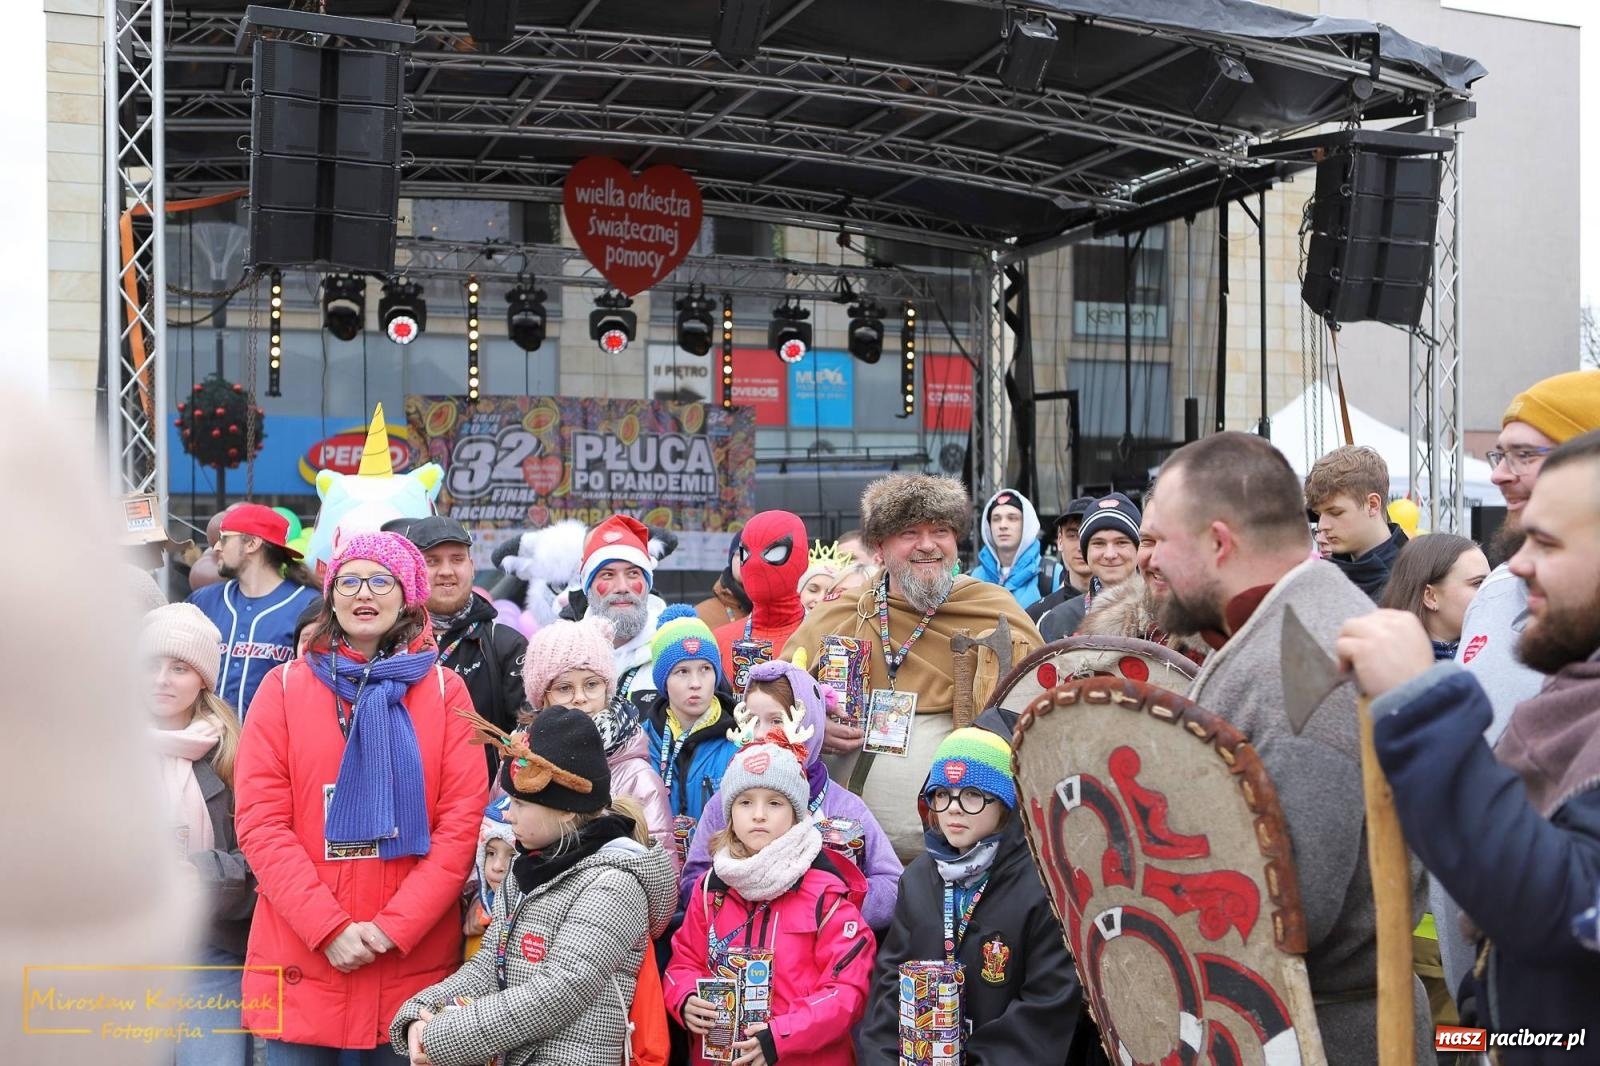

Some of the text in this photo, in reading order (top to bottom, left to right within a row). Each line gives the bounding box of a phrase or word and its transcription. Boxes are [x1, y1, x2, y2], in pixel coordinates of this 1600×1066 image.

[575, 178, 691, 218] wielka orkiestra
[587, 208, 680, 256] świątecznej
[605, 245, 665, 278] pomocy
[665, 366, 708, 379] PIĘTRO
[318, 445, 404, 467] PEPO
[450, 430, 538, 492] 32
[575, 434, 714, 473] PŁUCA
[575, 471, 604, 490] PO
[610, 471, 715, 493] PANDEMII
[449, 503, 526, 520] RACIBÓRZ
[751, 968, 765, 977] tvn
